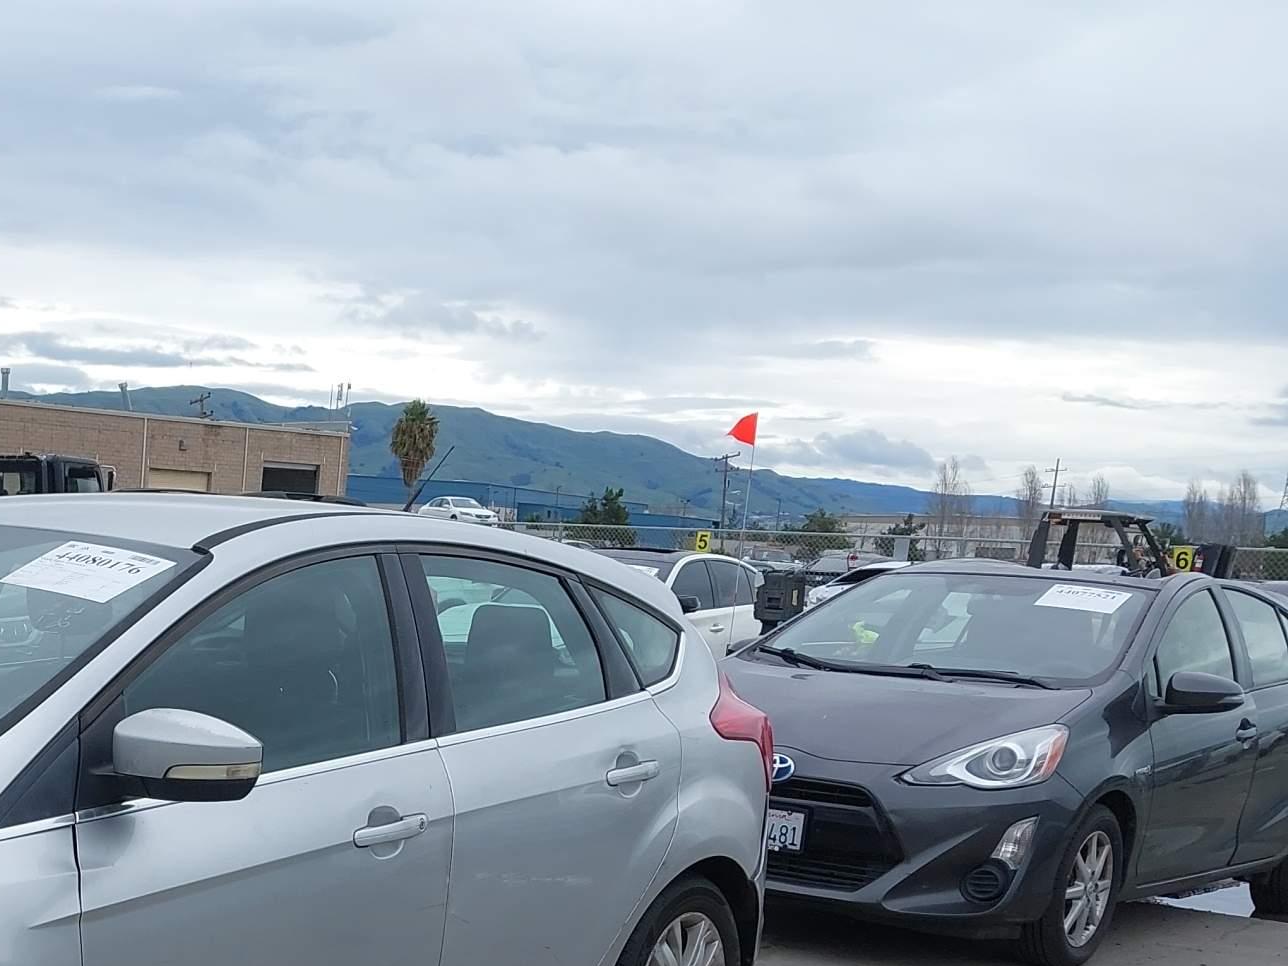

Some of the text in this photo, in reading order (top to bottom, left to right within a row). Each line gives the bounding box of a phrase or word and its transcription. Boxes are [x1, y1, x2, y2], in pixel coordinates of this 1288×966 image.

[697, 534, 708, 550] 5
[56, 551, 146, 574] 44080176
[1175, 551, 1189, 569] 6
